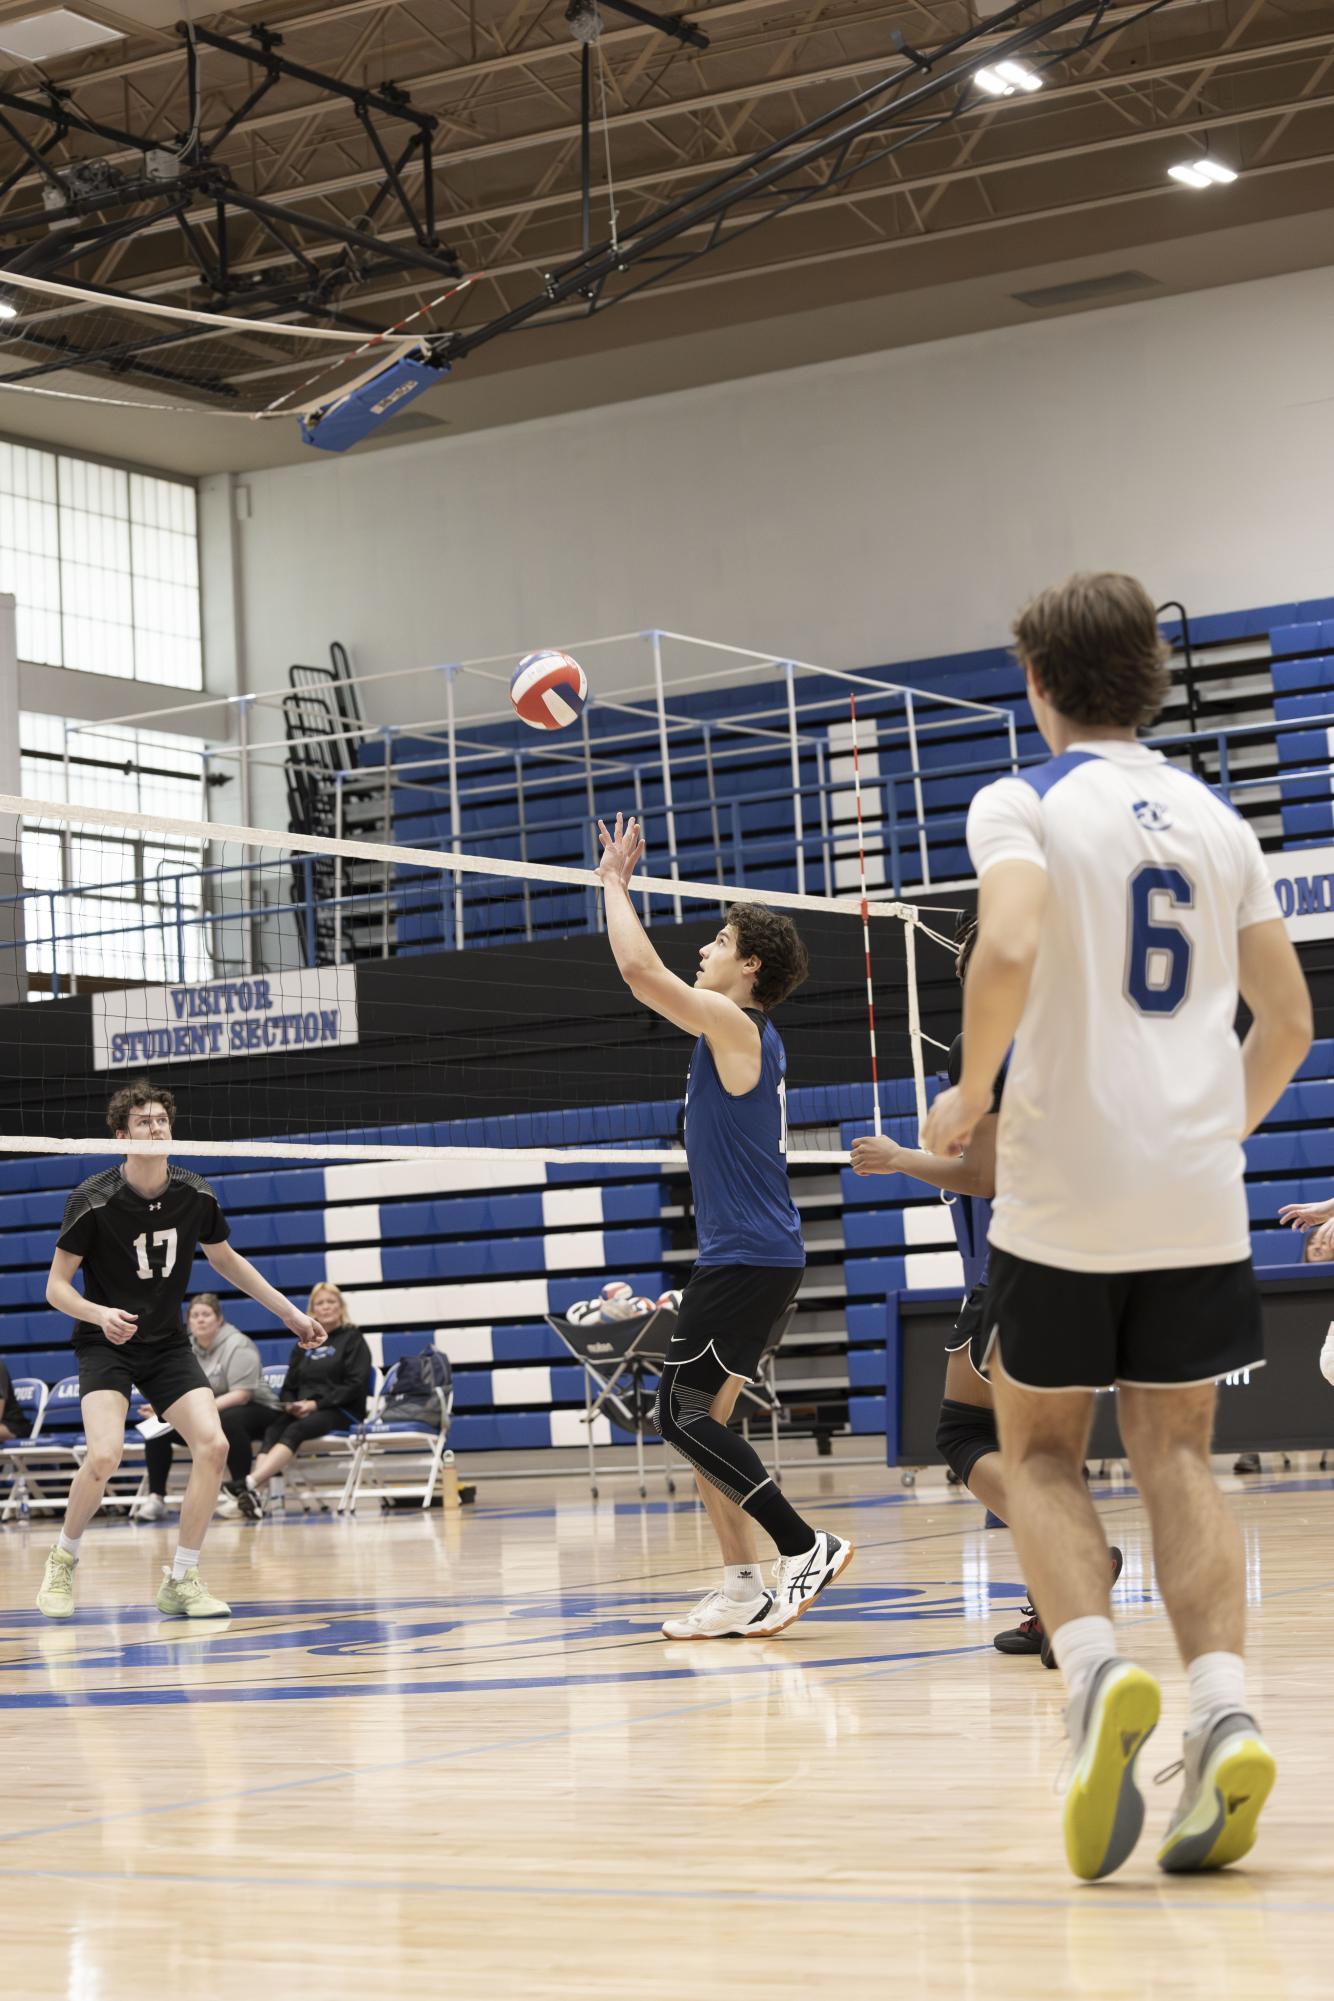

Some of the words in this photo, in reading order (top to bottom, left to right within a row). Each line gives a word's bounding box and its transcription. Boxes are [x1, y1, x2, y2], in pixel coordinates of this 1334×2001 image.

[1273, 873, 1334, 918] OM
[1122, 861, 1195, 1019] 6
[170, 980, 273, 1019] VISITOR
[111, 1023, 223, 1063] STUDENT
[230, 1009, 338, 1051] SECTION
[133, 1228, 178, 1279] 17
